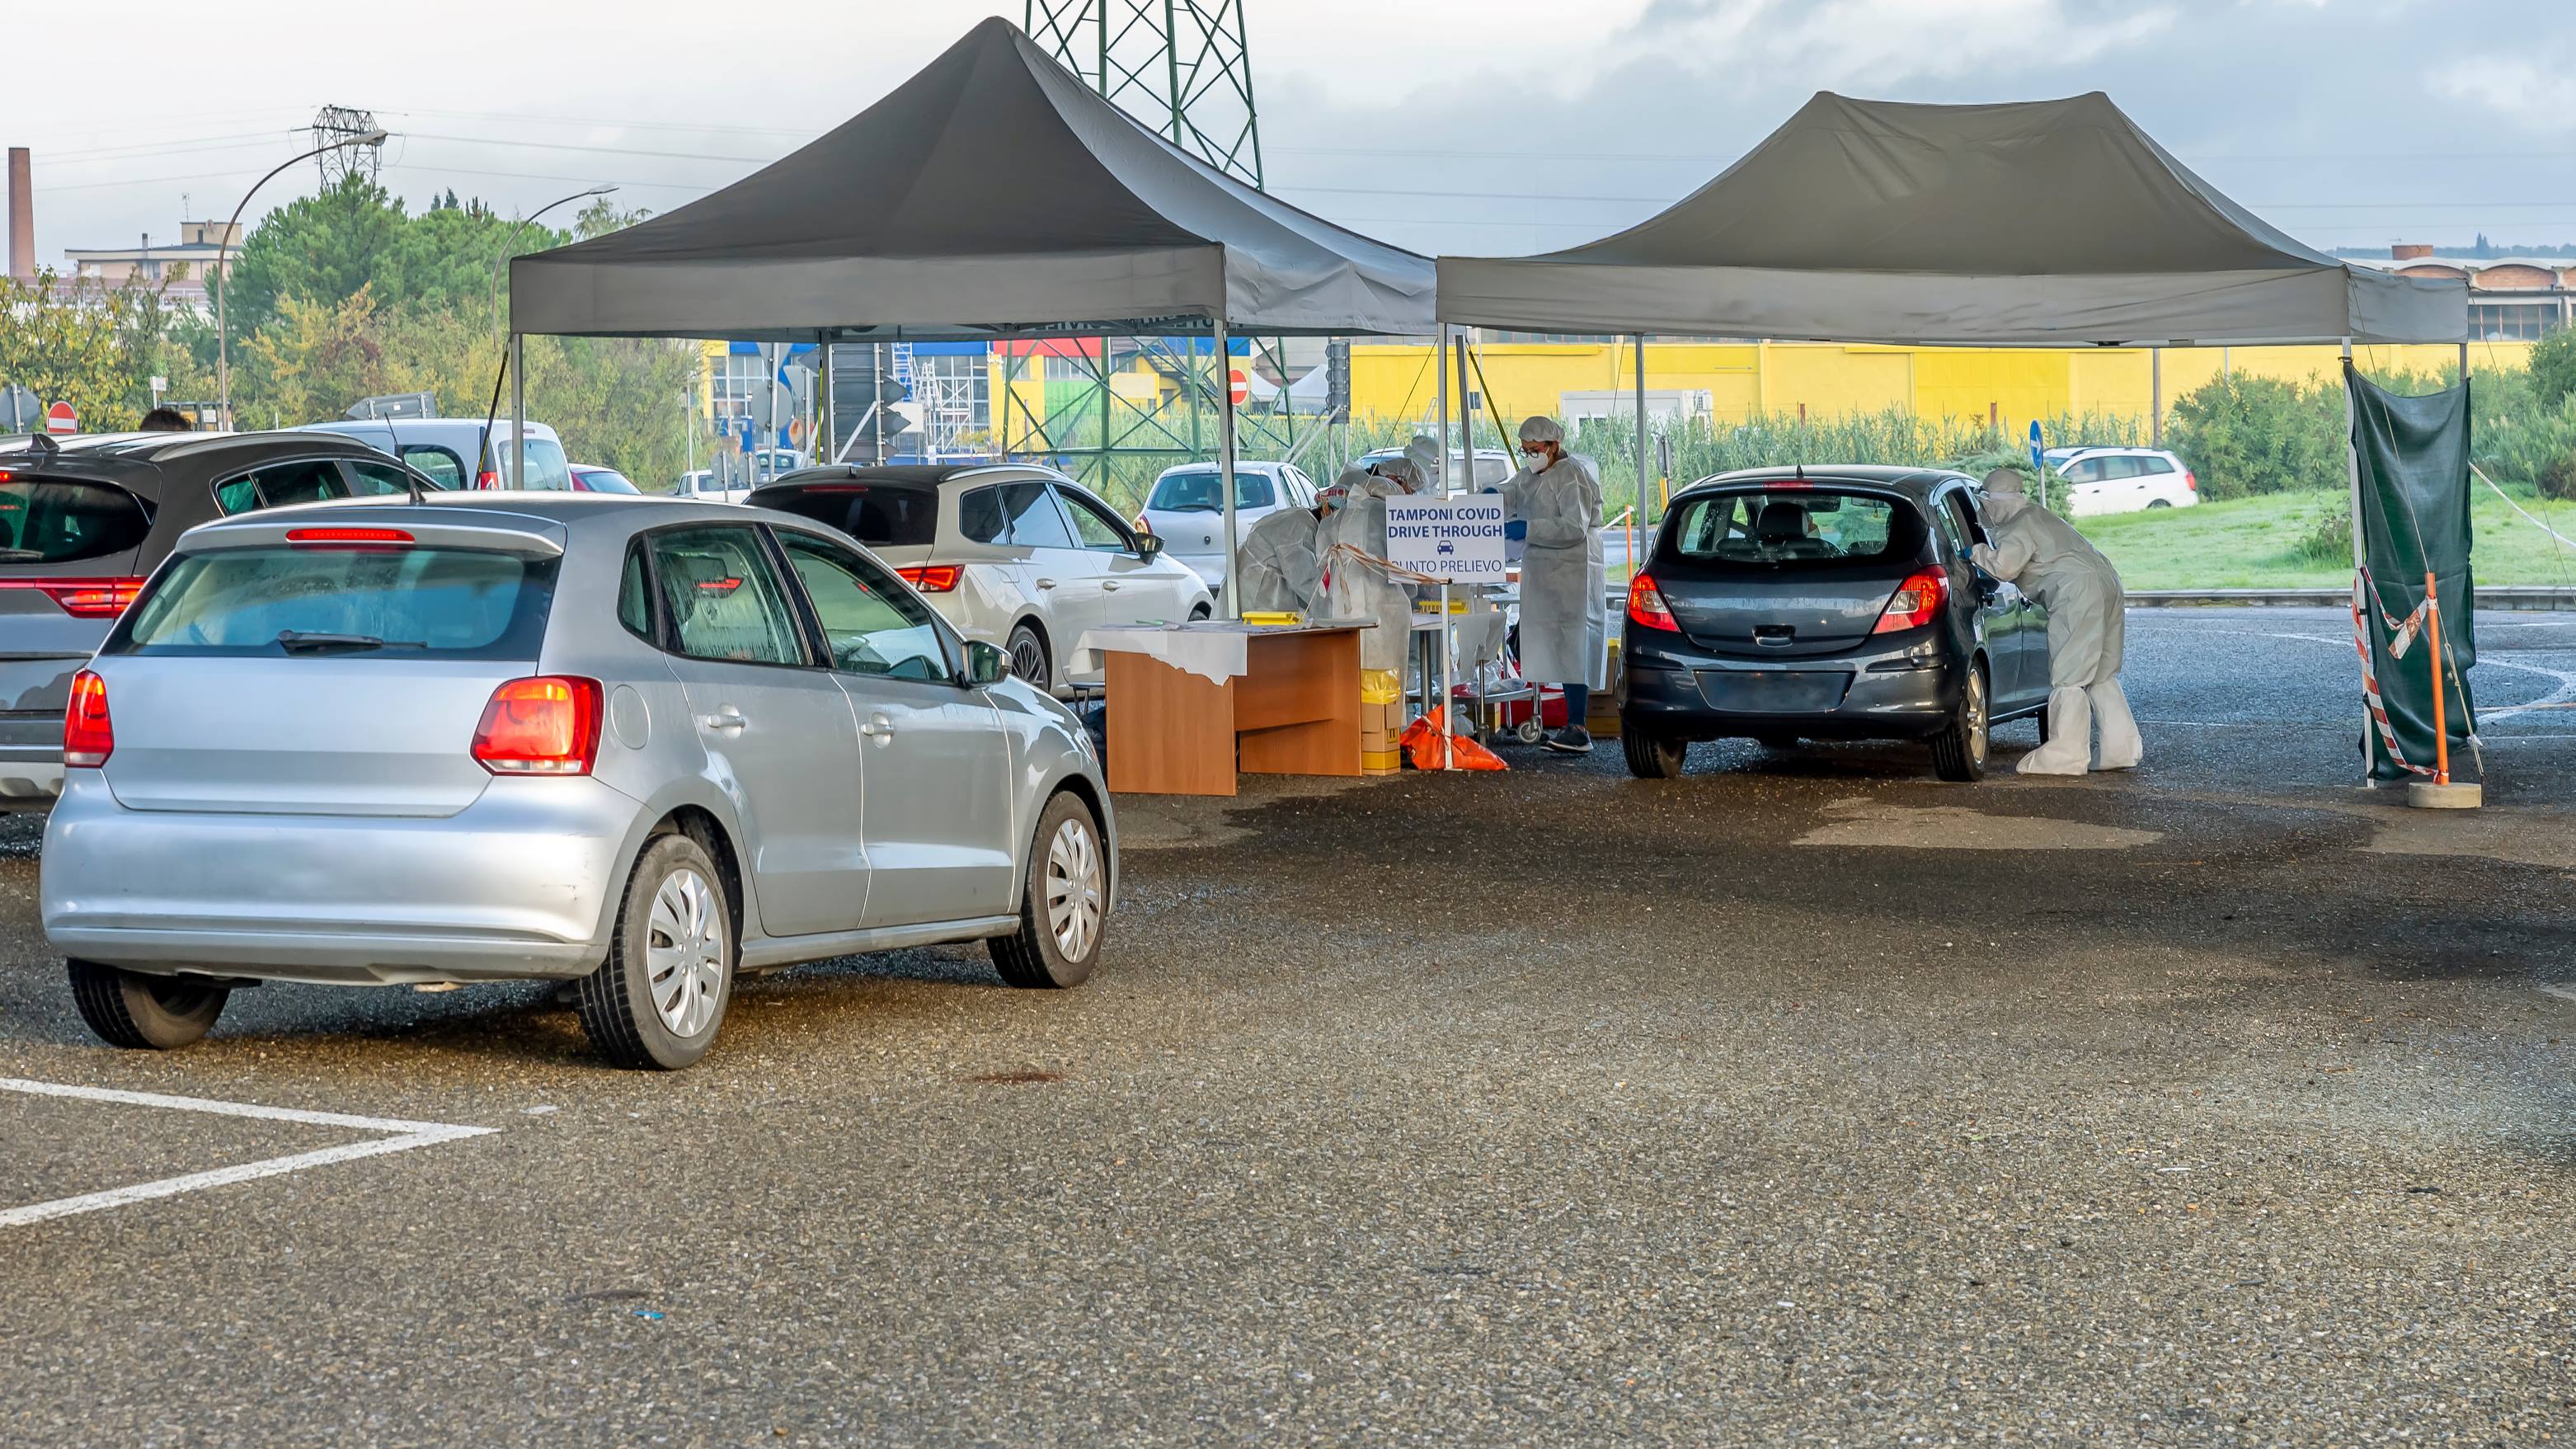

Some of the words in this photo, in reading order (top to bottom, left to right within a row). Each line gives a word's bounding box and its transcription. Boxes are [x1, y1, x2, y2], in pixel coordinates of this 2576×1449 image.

[1388, 509, 1453, 521] TAMPONI
[1456, 508, 1502, 520] COVID
[1388, 525, 1430, 539] DRIVE
[1431, 525, 1502, 538] THROUGH
[1441, 560, 1502, 573] PRELIEVO
